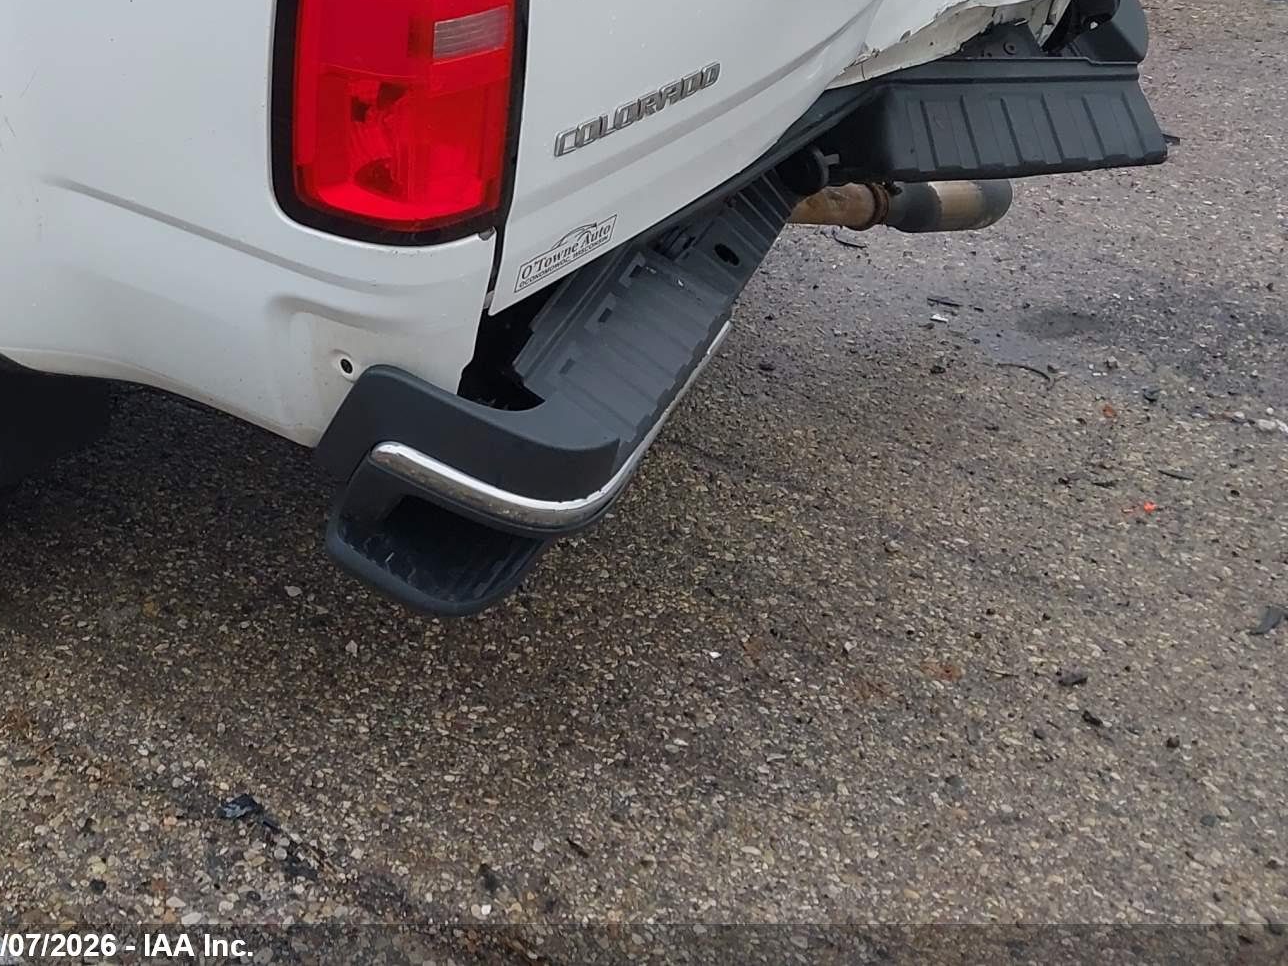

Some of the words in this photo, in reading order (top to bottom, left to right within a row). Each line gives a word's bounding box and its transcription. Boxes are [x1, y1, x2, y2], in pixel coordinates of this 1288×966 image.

[554, 59, 721, 157] COLORADO
[521, 242, 579, 280] O'Towne
[580, 224, 611, 248] Auto
